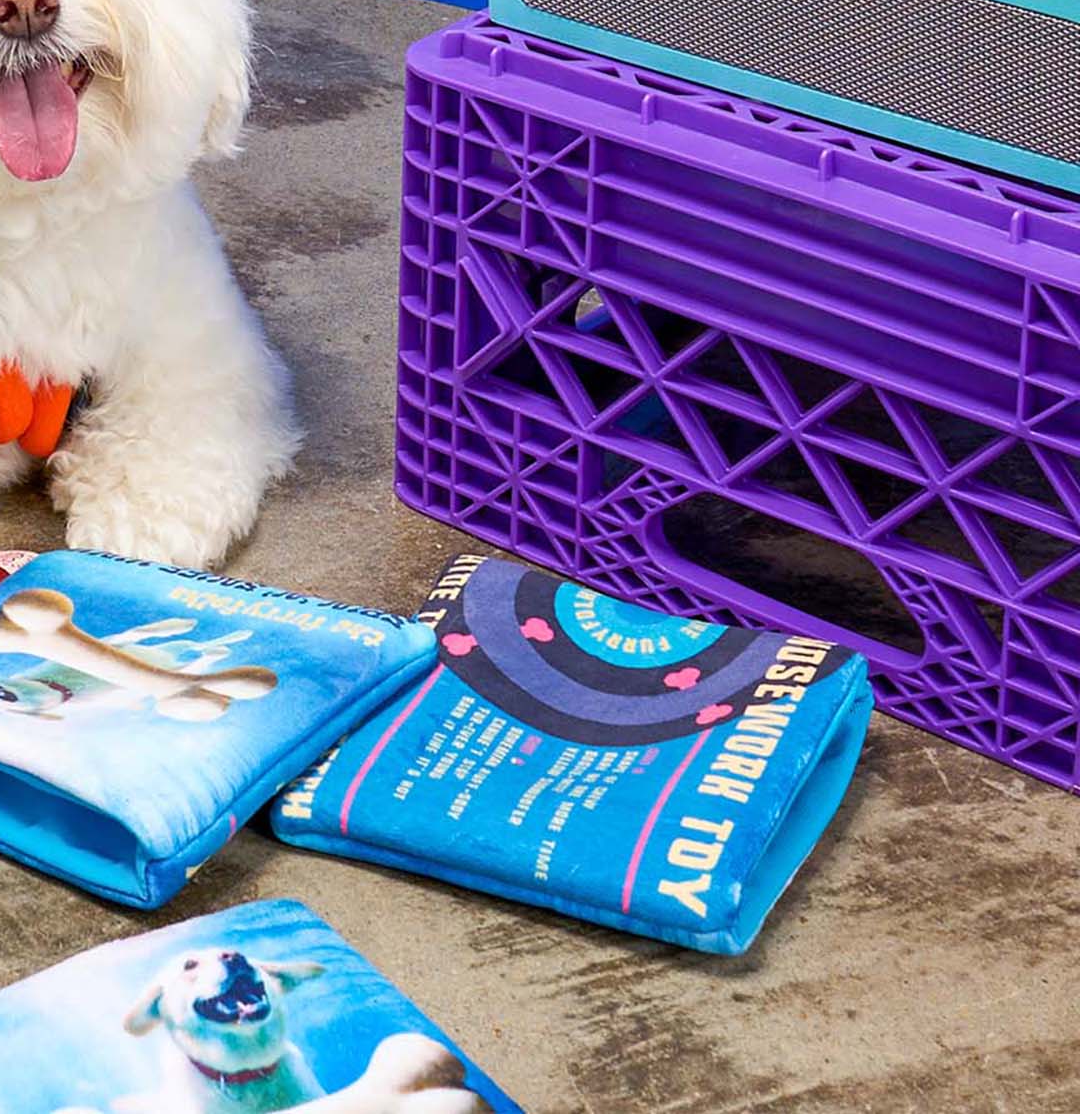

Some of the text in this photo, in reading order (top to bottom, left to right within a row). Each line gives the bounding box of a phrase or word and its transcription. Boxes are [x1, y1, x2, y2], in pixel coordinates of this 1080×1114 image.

[427, 554, 489, 602] HIDE
[573, 587, 672, 655] FURRYFOLK
[657, 632, 839, 920] NOSEWORK TOY
[547, 800, 576, 833] MORE
[534, 839, 557, 882] TIME
